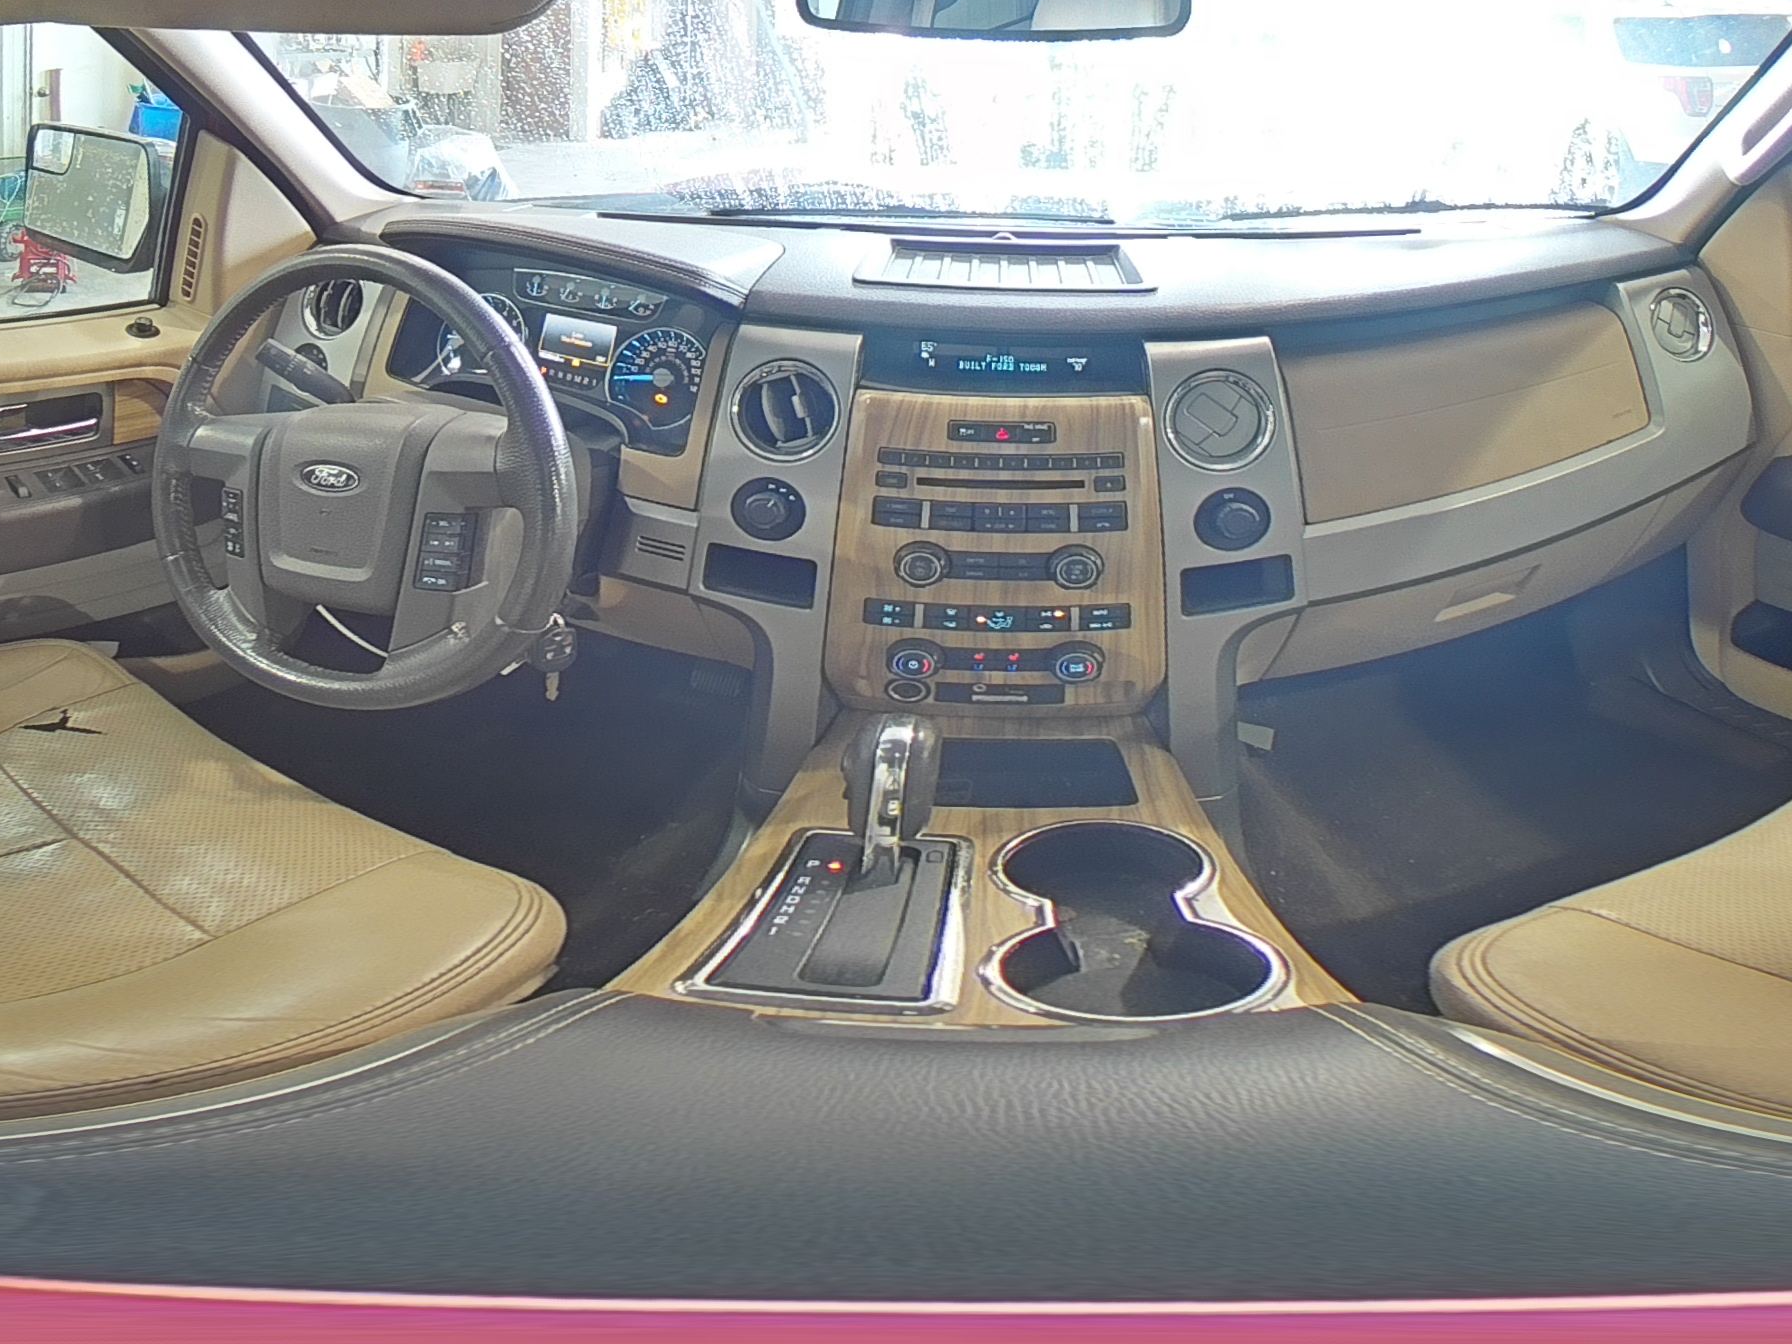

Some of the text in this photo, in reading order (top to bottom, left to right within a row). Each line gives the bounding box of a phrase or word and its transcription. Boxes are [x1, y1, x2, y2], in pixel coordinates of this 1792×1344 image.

[959, 360, 986, 370] BUILT
[1019, 363, 1047, 372] TOUGH
[310, 467, 347, 487] Ford
